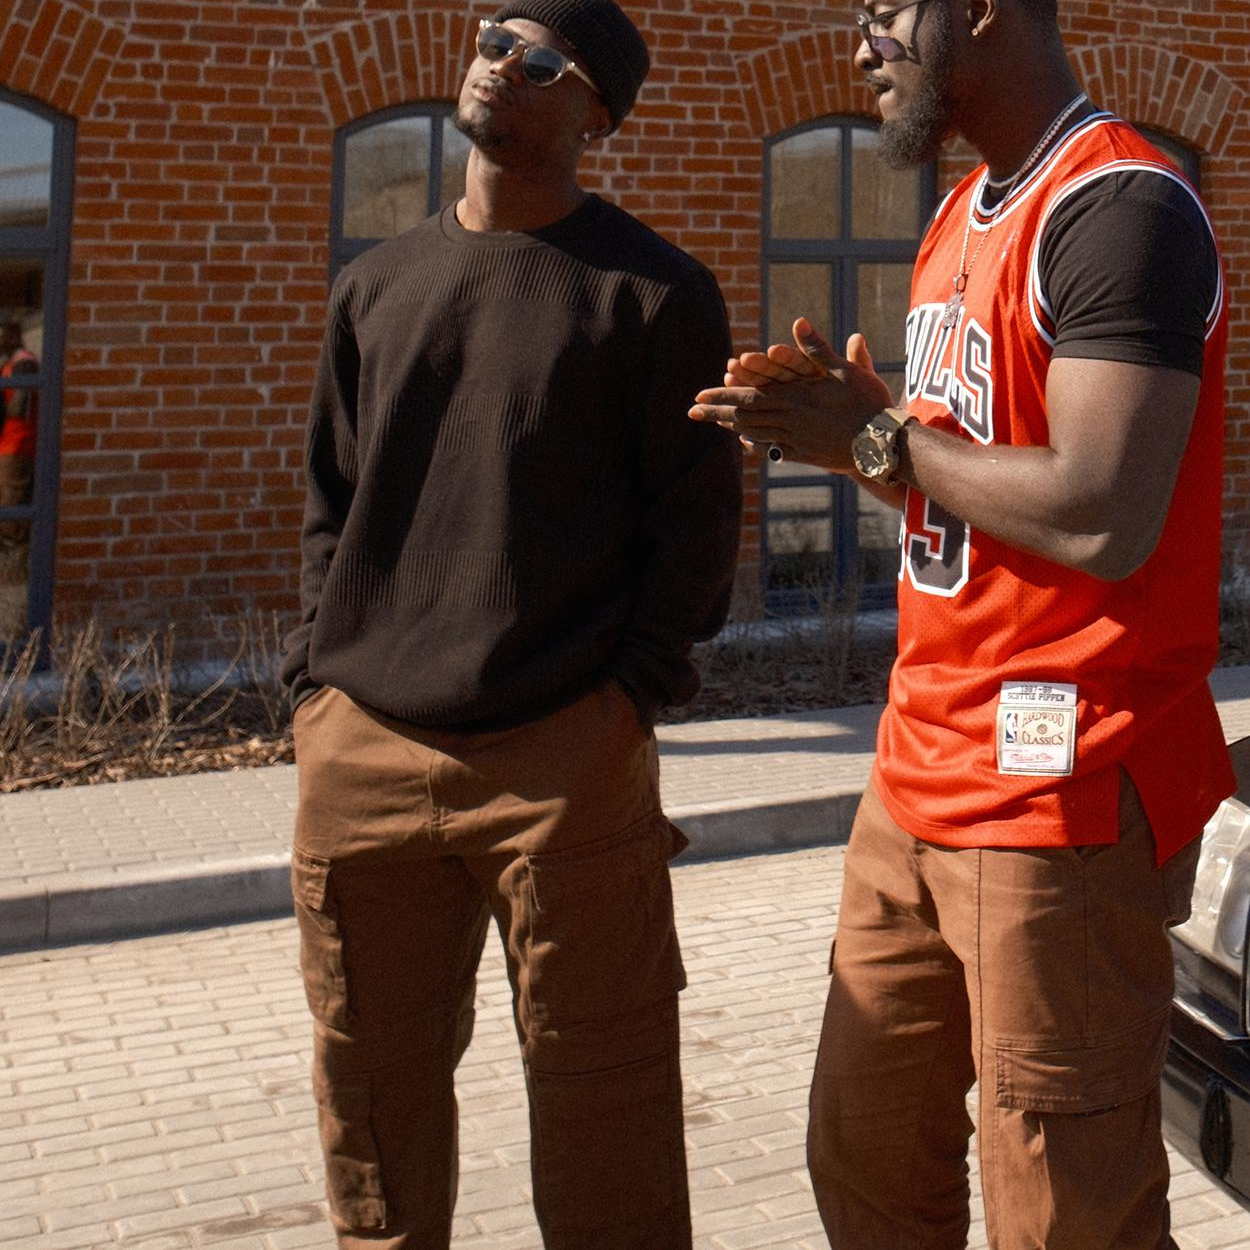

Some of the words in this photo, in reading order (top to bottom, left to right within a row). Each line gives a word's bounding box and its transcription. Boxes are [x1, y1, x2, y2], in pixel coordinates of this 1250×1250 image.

[1008, 692, 1036, 701] SCOTTIE
[1039, 693, 1065, 702] PIPPEN
[1022, 731, 1064, 745] CLASSICS
